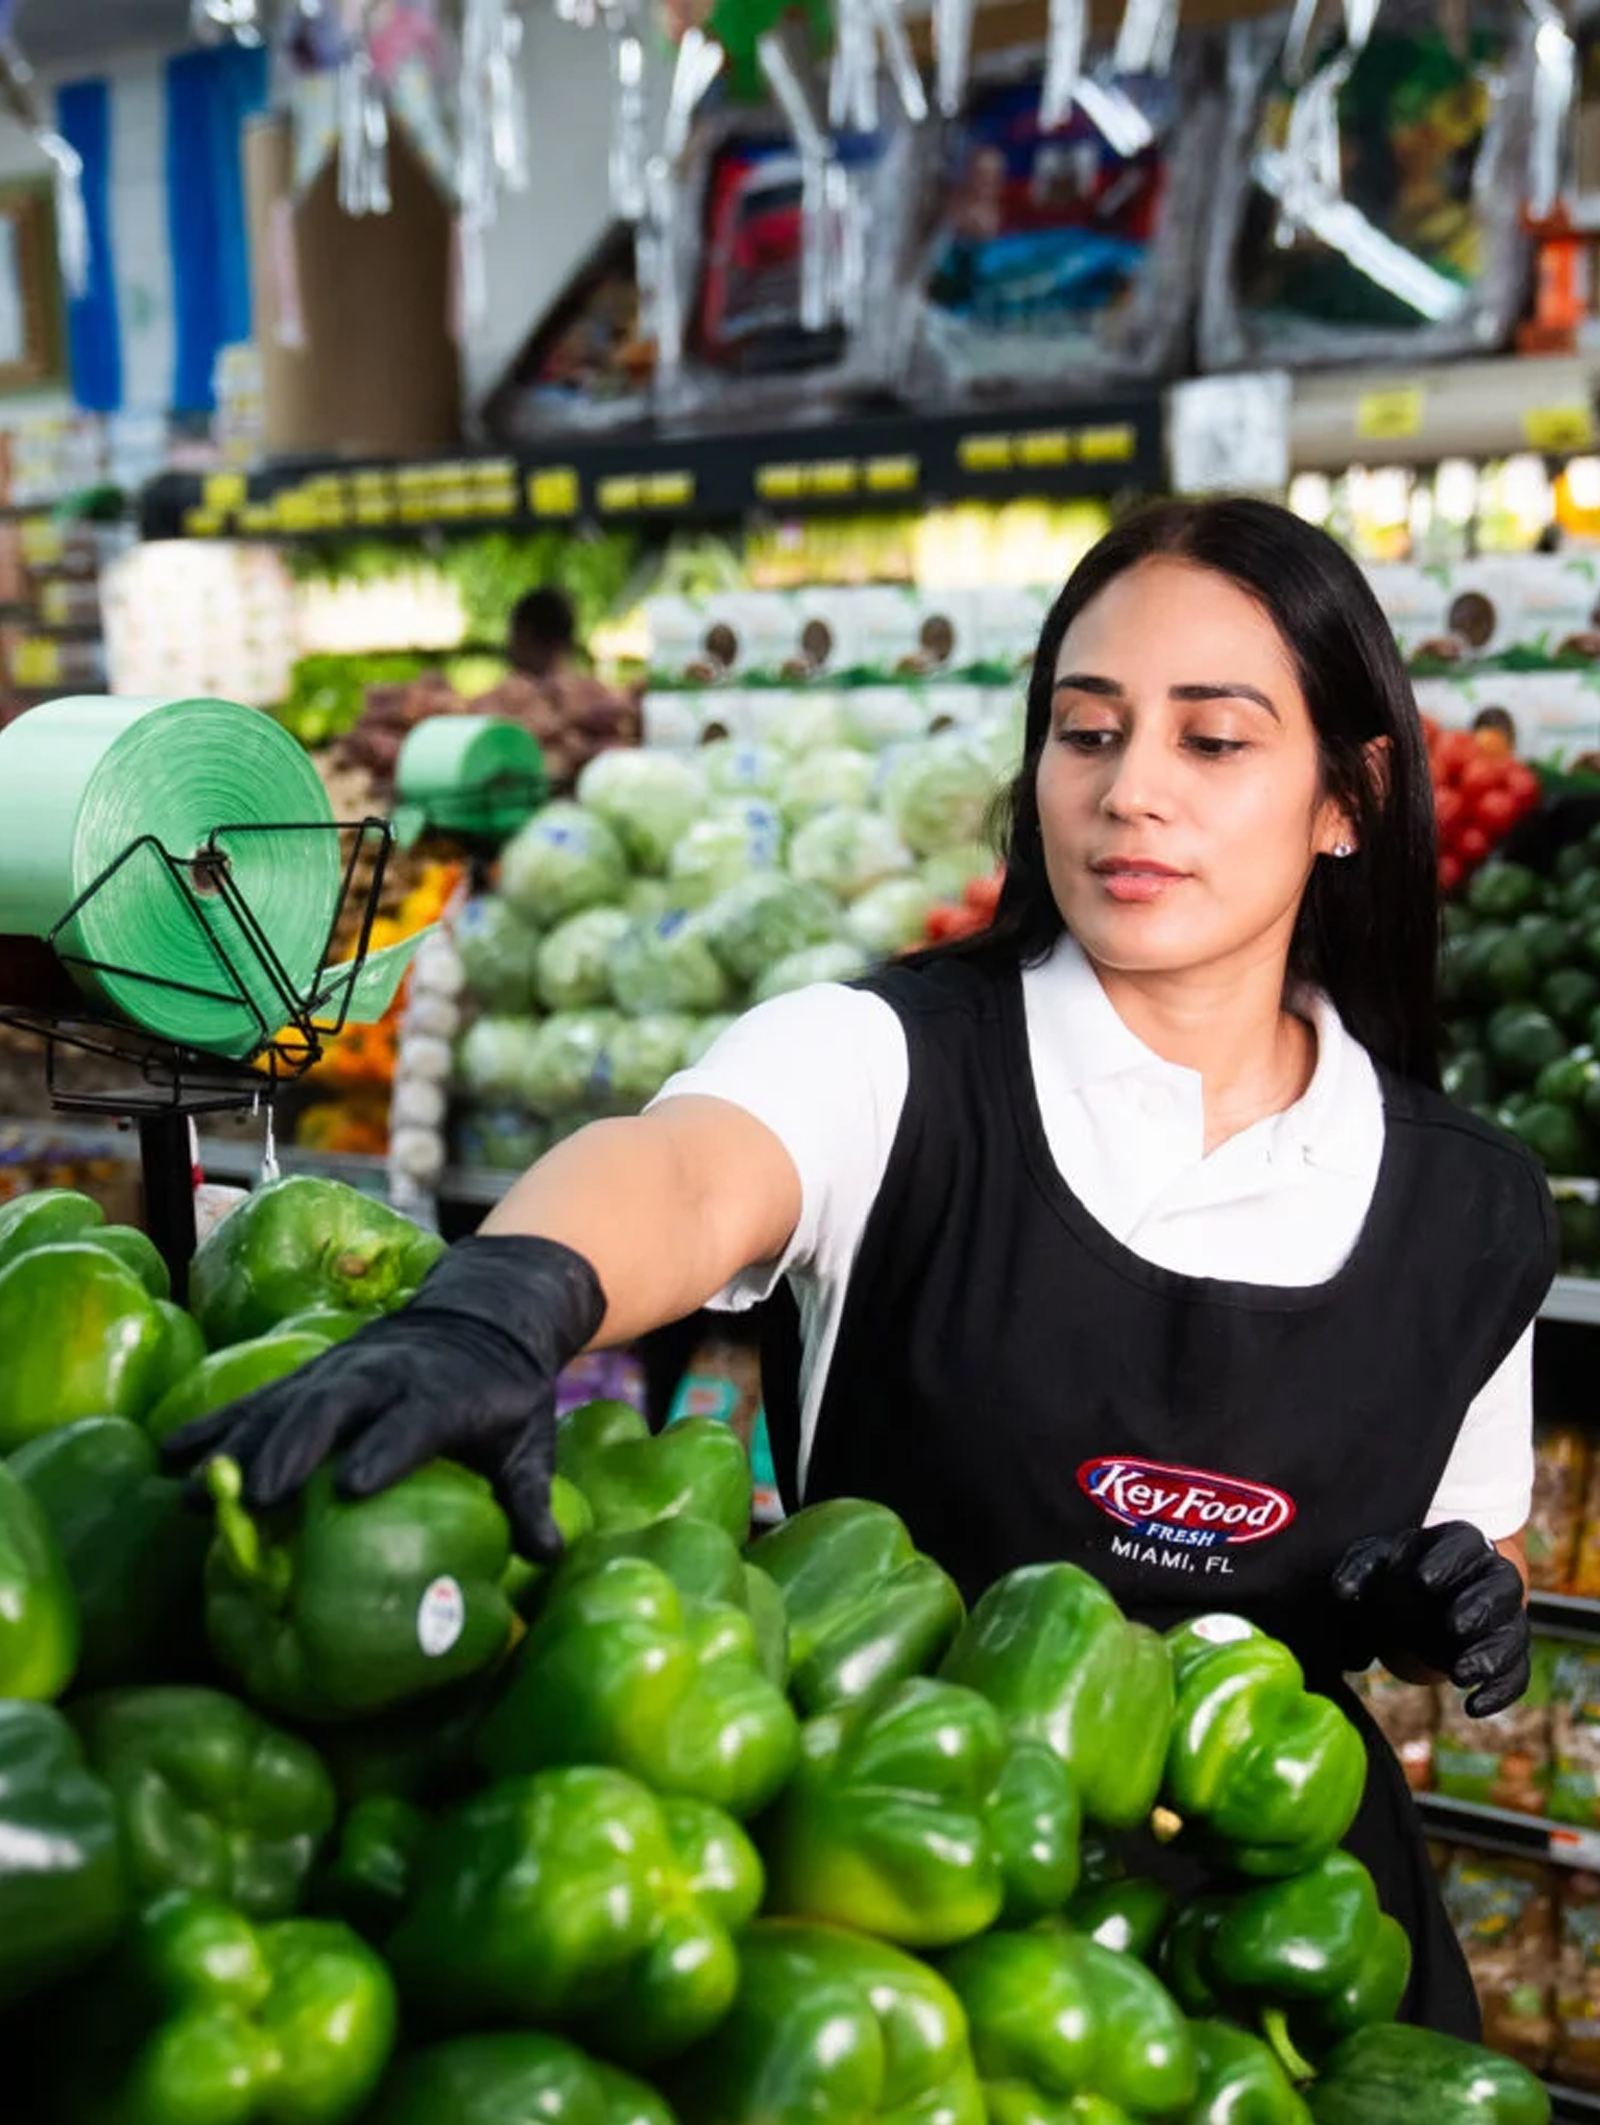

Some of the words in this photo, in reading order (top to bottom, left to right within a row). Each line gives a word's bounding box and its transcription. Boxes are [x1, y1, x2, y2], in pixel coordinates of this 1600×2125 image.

[1146, 1523, 1216, 1547] FRESH
[1111, 1537, 1195, 1572] MIAMI,
[1204, 1555, 1235, 1574] FL
